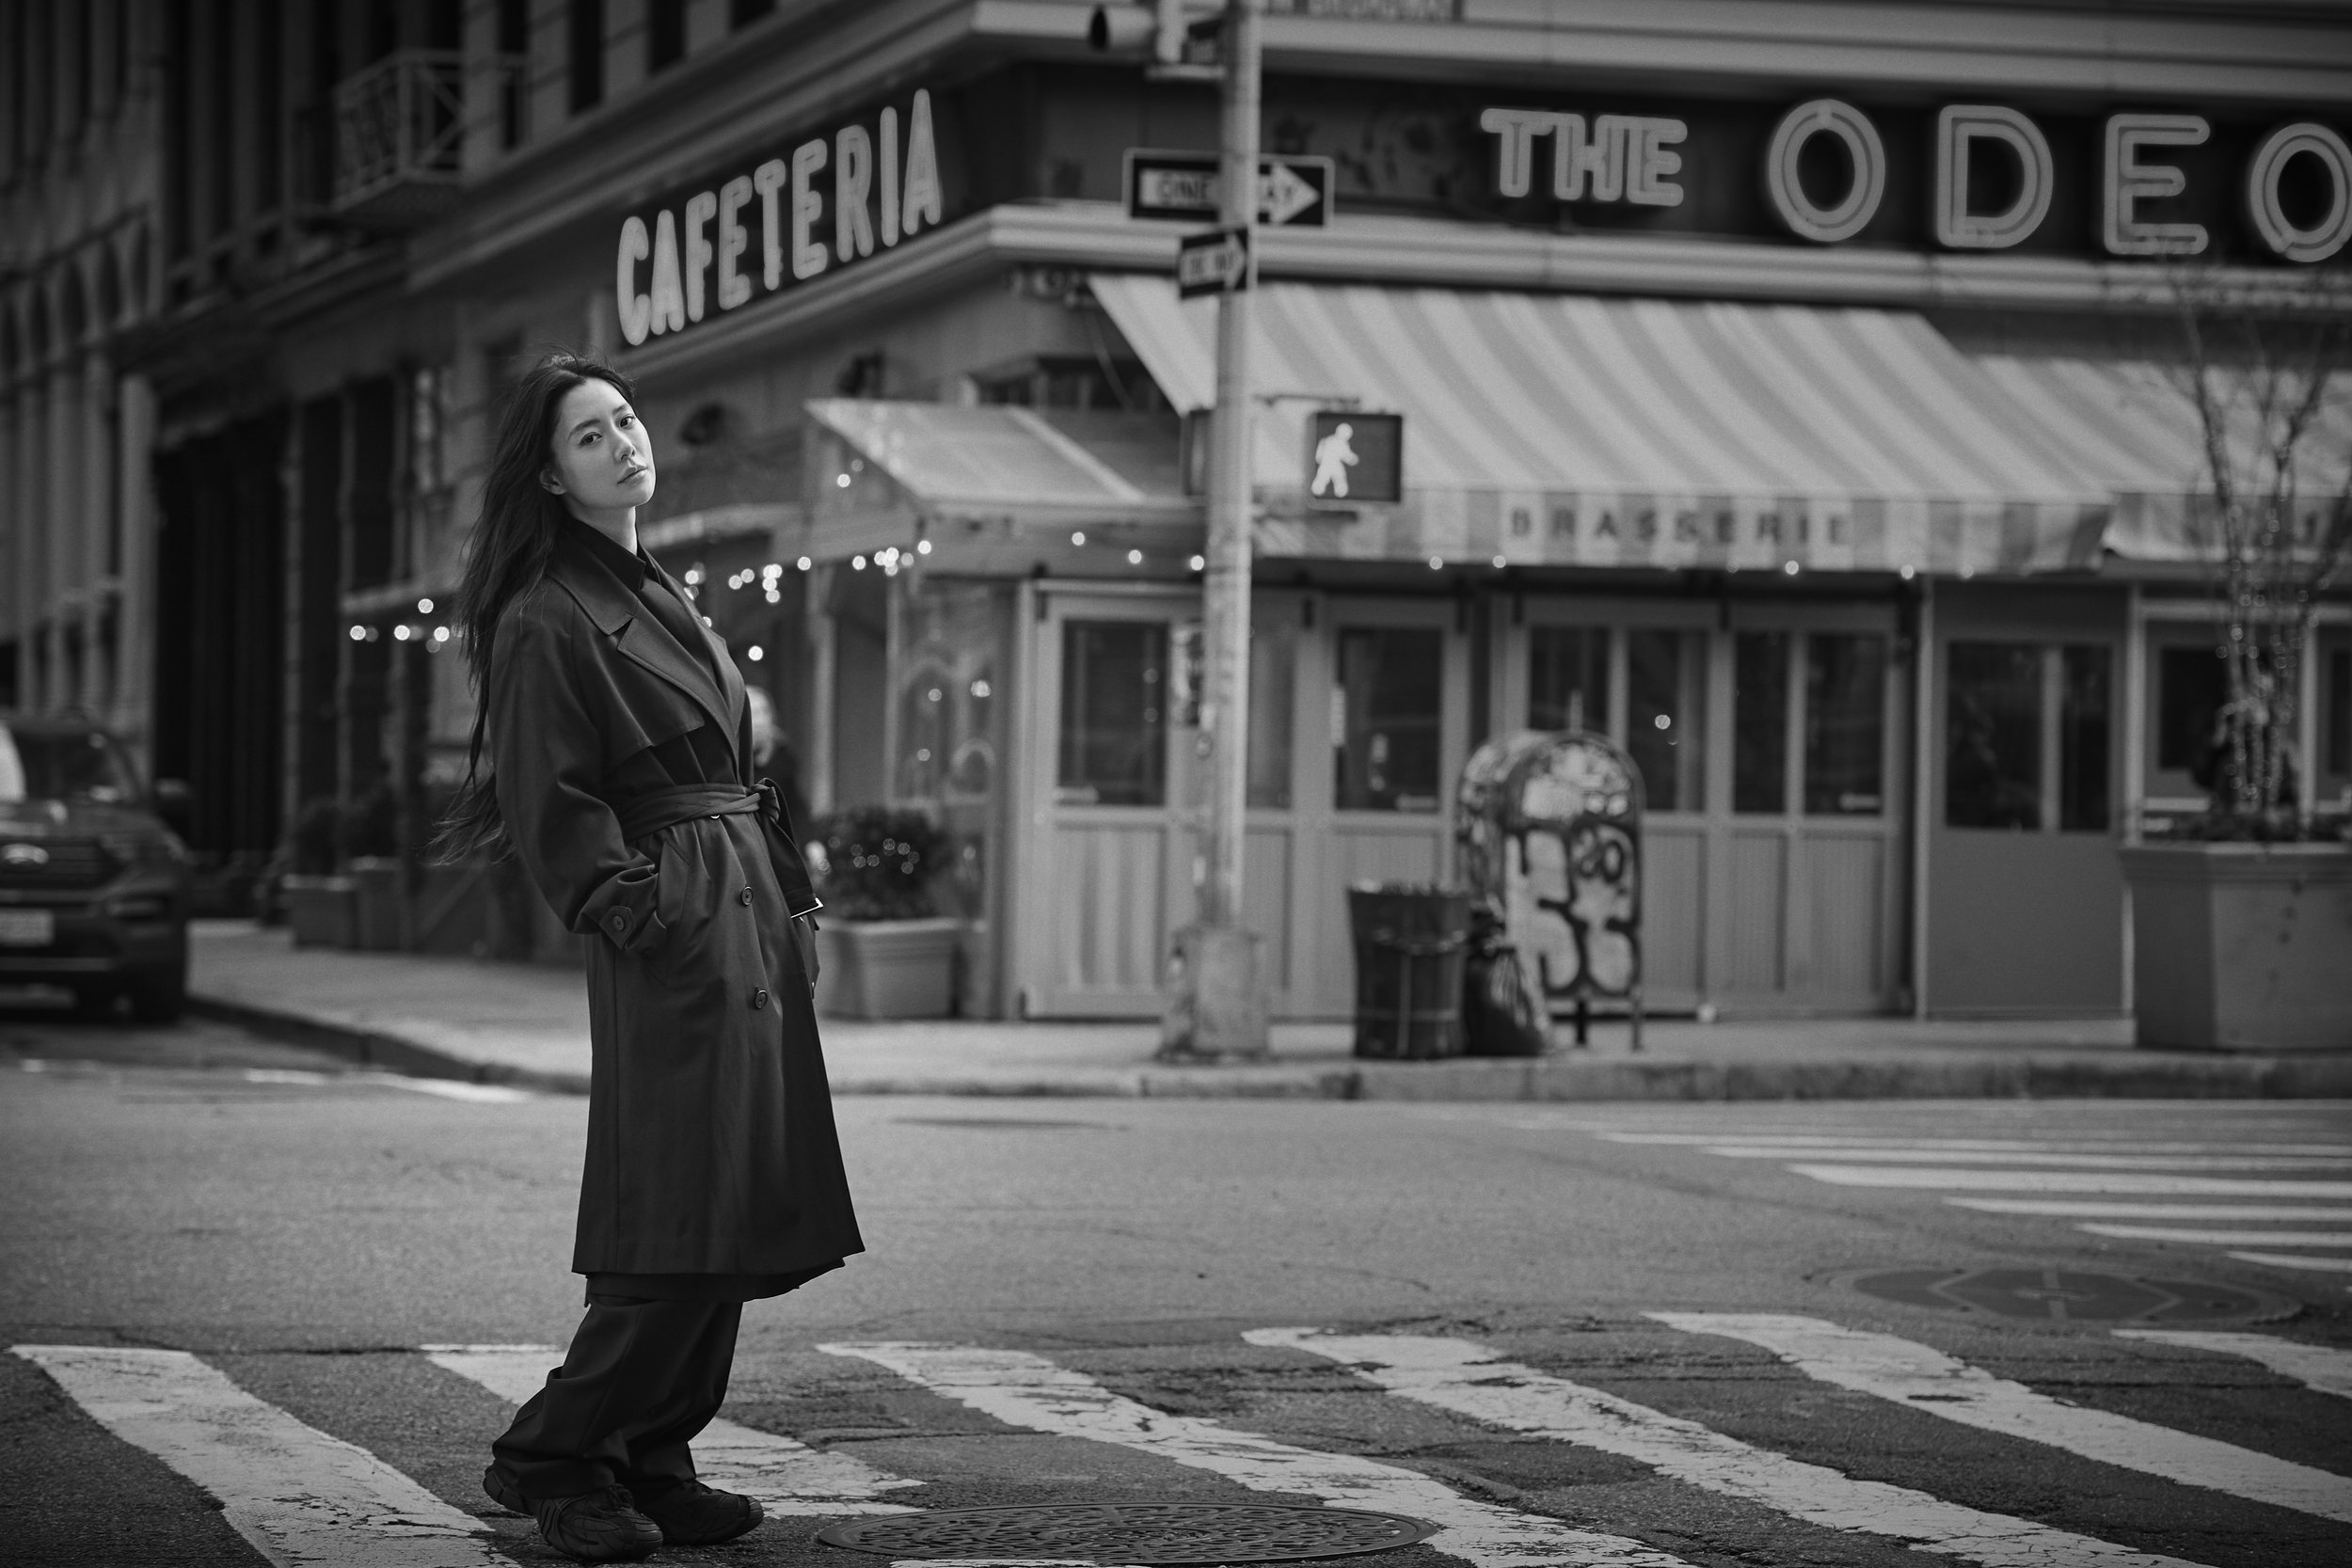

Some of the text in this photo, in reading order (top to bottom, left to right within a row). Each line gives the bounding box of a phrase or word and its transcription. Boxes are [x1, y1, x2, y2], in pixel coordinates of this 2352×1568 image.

[617, 87, 941, 346] CAFETERIA
[1480, 98, 2352, 262] THE ODEO
[1511, 508, 1848, 545] BRASSERIE
